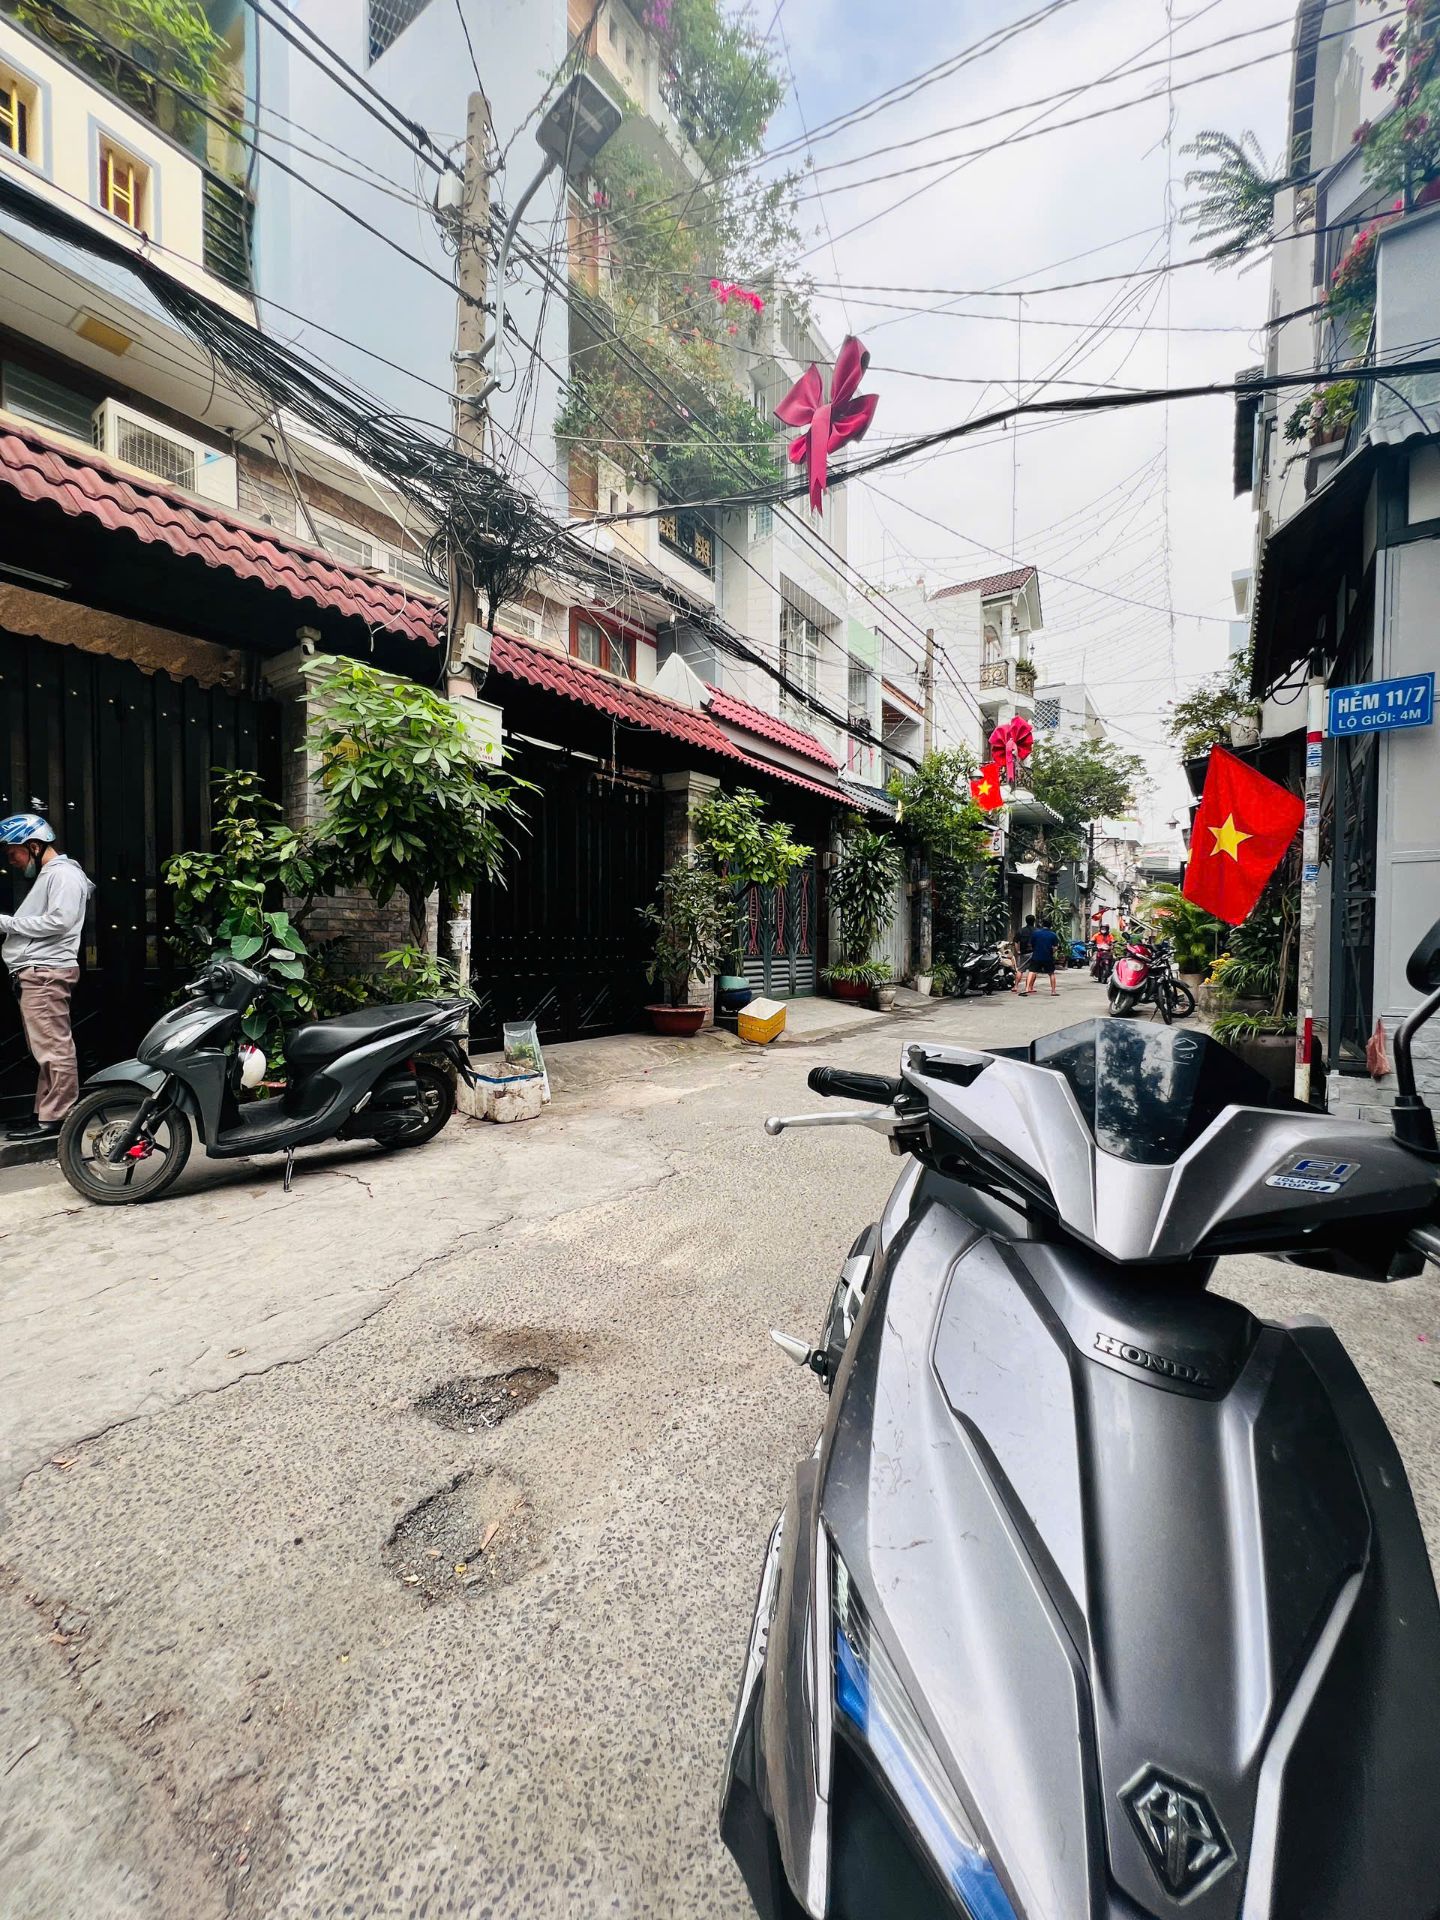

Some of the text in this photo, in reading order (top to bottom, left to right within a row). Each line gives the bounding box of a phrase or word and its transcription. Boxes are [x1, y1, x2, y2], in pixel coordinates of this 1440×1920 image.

[1338, 686, 1426, 714] HẺM 11/7
[1338, 708, 1421, 729] LỘ GIỚI: 4M
[1292, 1159, 1351, 1175] FI
[1276, 1177, 1319, 1186] IDLING
[1094, 1332, 1211, 1385] HONDA
